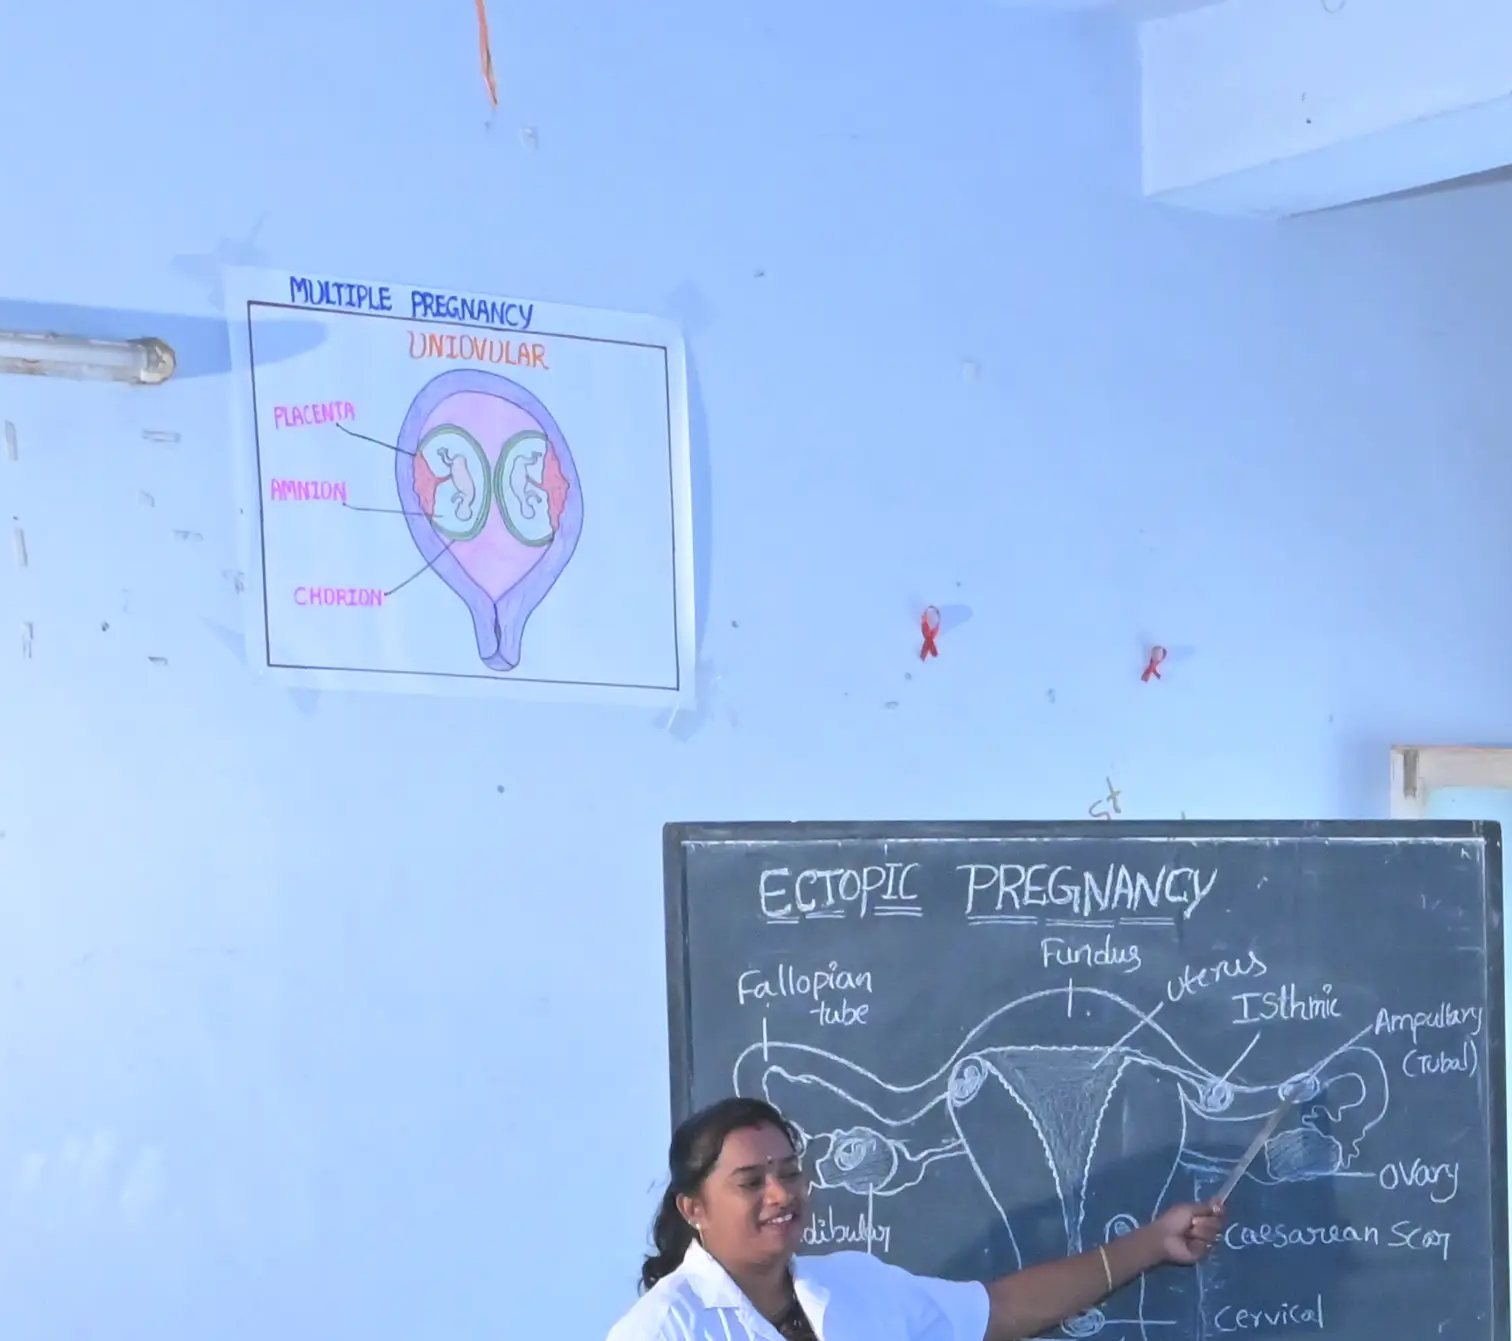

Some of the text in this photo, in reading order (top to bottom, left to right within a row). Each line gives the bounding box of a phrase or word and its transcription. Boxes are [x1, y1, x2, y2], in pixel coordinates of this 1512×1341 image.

[290, 276, 534, 329] MULTIPLE PREGNANCY
[407, 330, 550, 370] UNIOVULAR
[274, 401, 356, 429] PLACENTA
[270, 479, 347, 501] AMNION
[293, 587, 383, 607] CHORION
[759, 862, 1218, 920] ECTOPIC PREGNANCY
[1041, 934, 1142, 973] Fundus
[737, 961, 873, 1005] Fallopian
